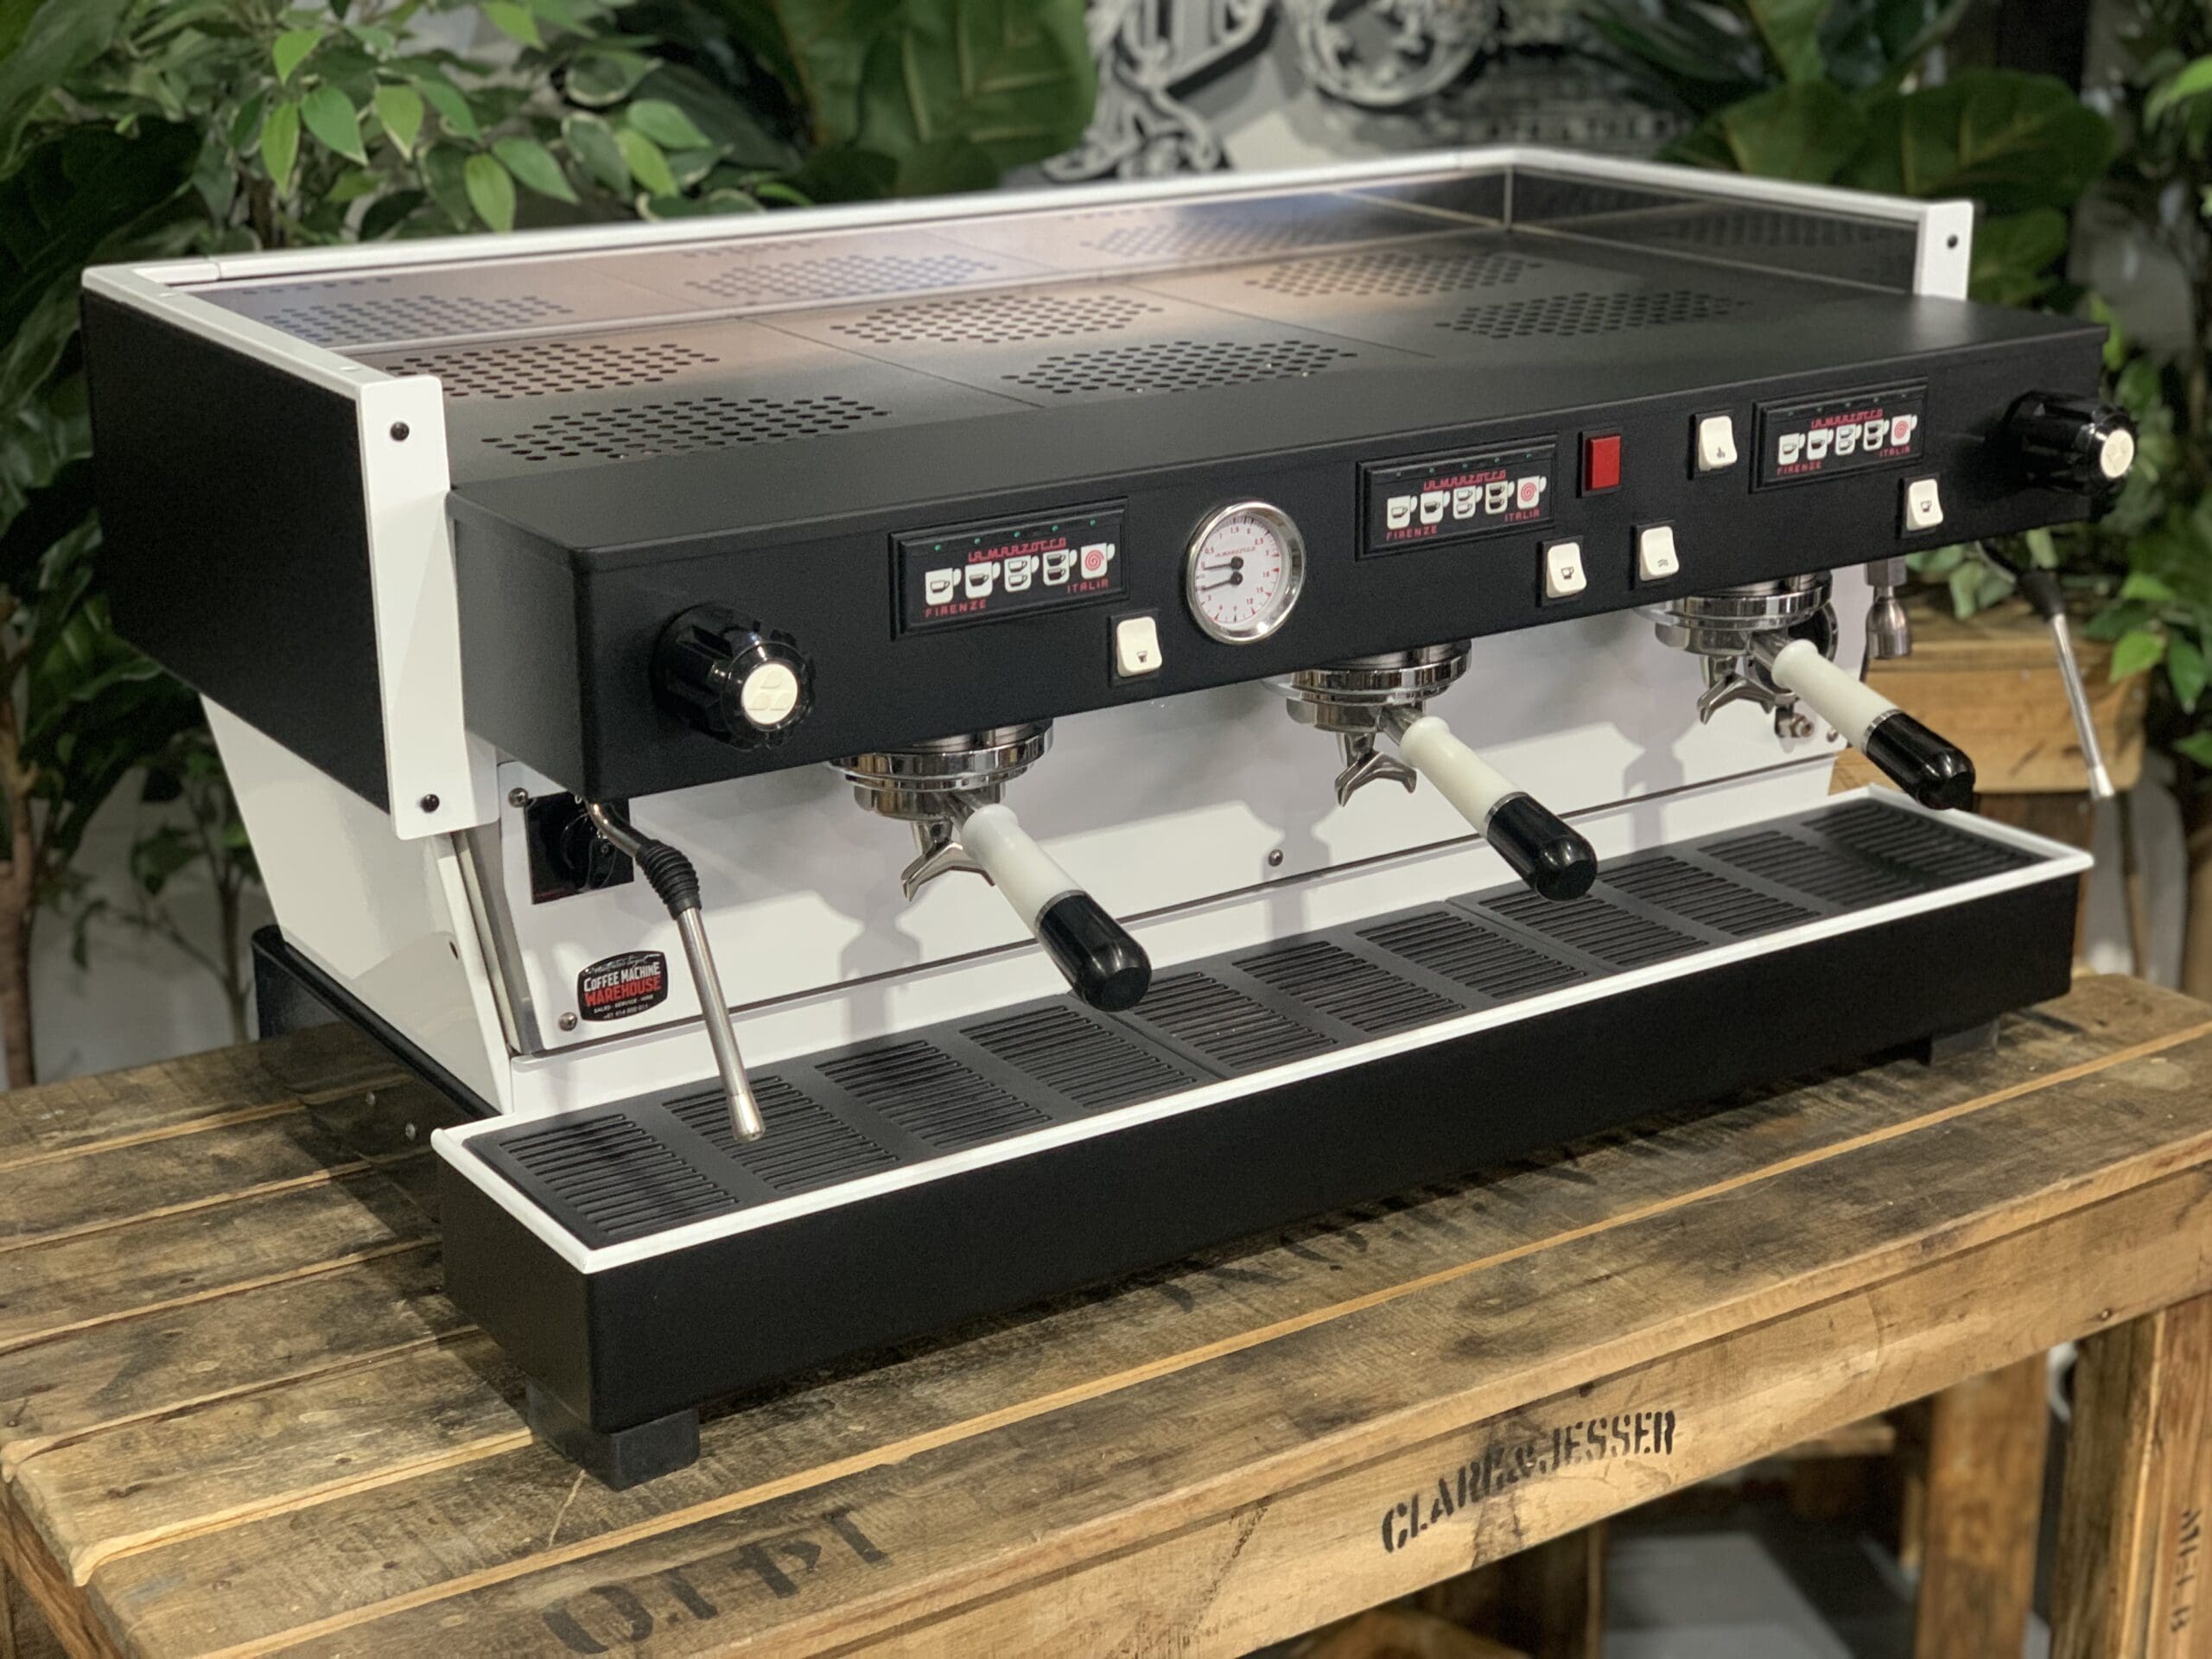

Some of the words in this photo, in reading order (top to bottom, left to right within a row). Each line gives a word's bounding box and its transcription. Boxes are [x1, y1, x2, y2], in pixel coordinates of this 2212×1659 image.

[1878, 445, 1910, 458] ITALIA
[1777, 461, 1822, 475] FIRENZE
[1504, 509, 1540, 522] ITALIA
[1386, 525, 1439, 541] FIRENZE
[1066, 578, 1109, 594] ITALIA
[925, 599, 987, 619] FIRENZE
[583, 972, 620, 992] COFFEE
[620, 962, 661, 982] MACHINE
[584, 975, 661, 1007] WAREHOUSE
